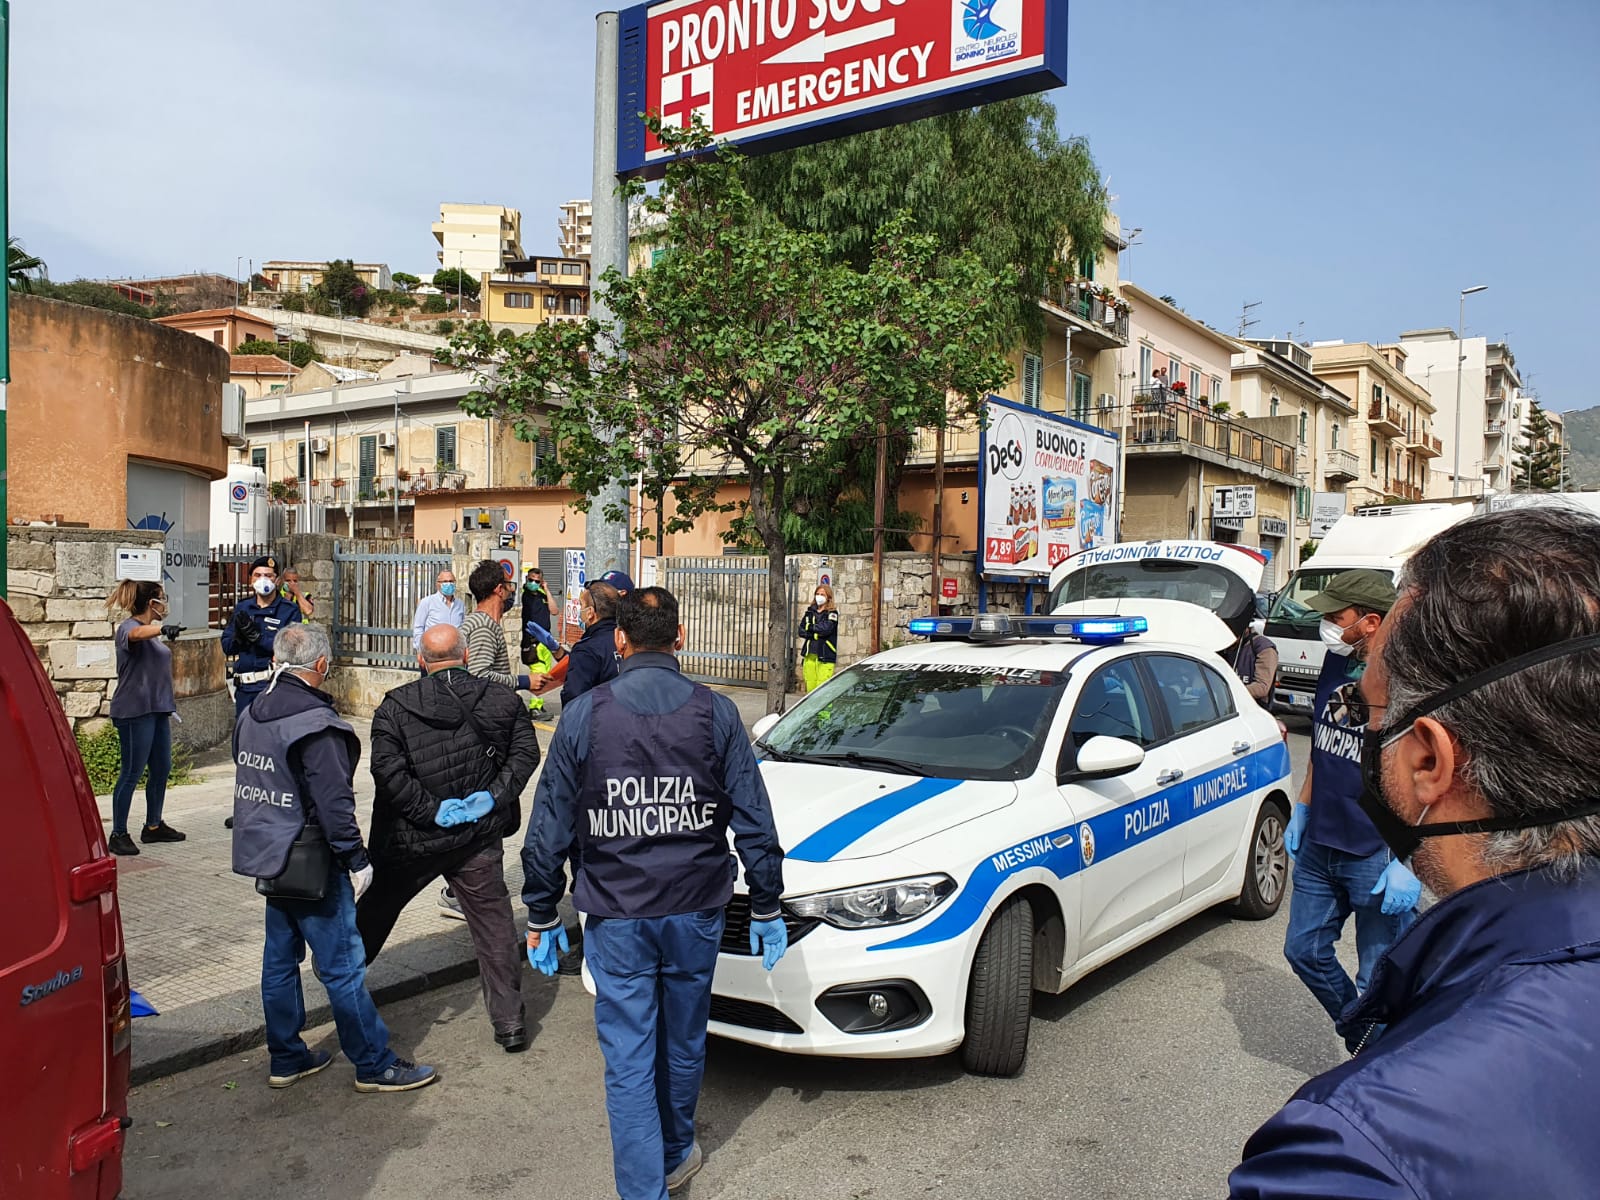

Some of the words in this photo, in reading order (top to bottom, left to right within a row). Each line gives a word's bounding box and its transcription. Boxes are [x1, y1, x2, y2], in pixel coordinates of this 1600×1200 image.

[662, 0, 797, 75] PRONTO
[955, 48, 985, 62] BONINO
[987, 40, 1016, 54] PULEJO
[736, 41, 935, 124] EMERGENCY
[1036, 430, 1078, 455] BUONO
[1081, 441, 1086, 460] E
[1236, 491, 1252, 500] lotto
[165, 552, 197, 568] BONINO
[1077, 544, 1160, 567] MUNICIPALE
[1166, 545, 1225, 561] POLIZIA
[920, 663, 1037, 679] MUNICIPALE
[607, 776, 696, 806] POLIZIA
[587, 803, 718, 838] MUNICIPALE
[992, 835, 1054, 873] MESSINA
[1124, 798, 1170, 841] POLIZIA
[1192, 767, 1248, 810] MUNICIPALE
